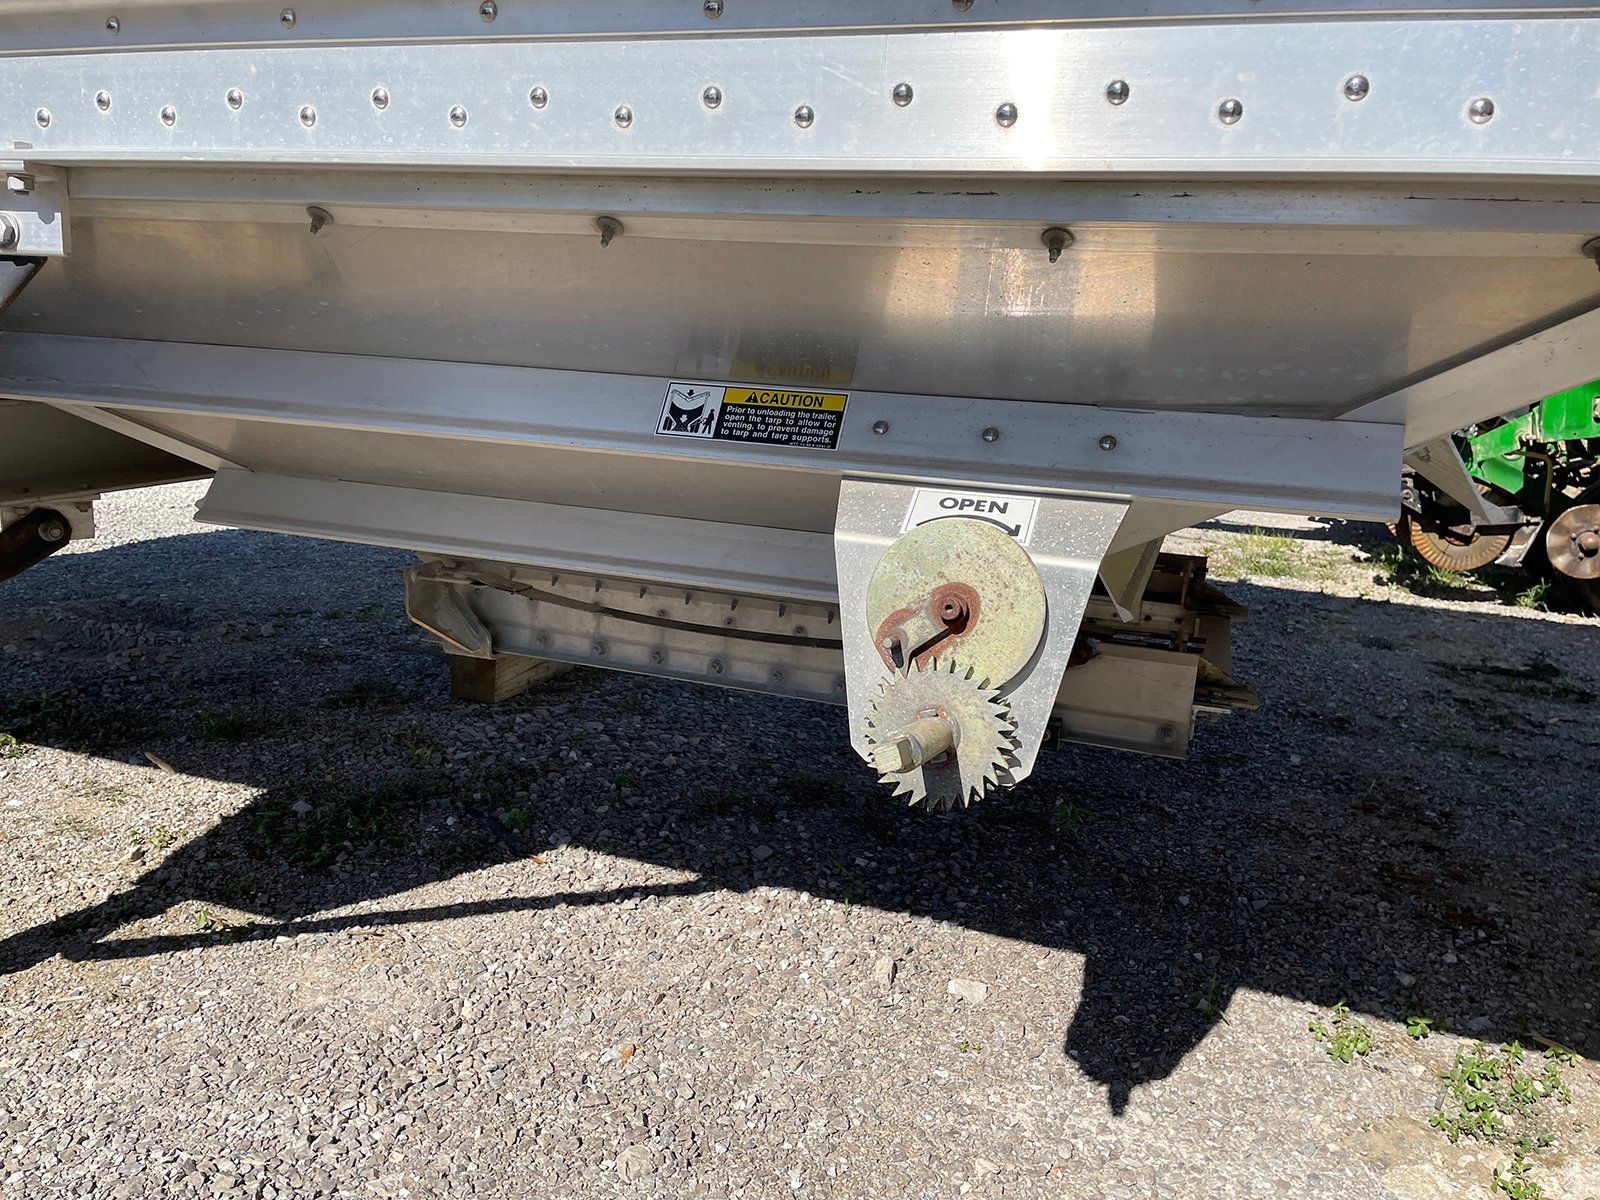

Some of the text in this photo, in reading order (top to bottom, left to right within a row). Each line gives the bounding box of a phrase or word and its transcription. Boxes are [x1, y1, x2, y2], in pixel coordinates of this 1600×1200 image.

[760, 392, 825, 408] CAUTION
[724, 414, 837, 428] open the tarp to allow for
[726, 405, 837, 422] Prior to unloading the trailer,
[723, 421, 834, 437] venting, to prevent damage
[732, 429, 749, 438] tarp
[752, 430, 769, 438] and
[771, 432, 789, 441] tarp
[791, 434, 832, 444] supports.
[939, 497, 1009, 514] OPEN
